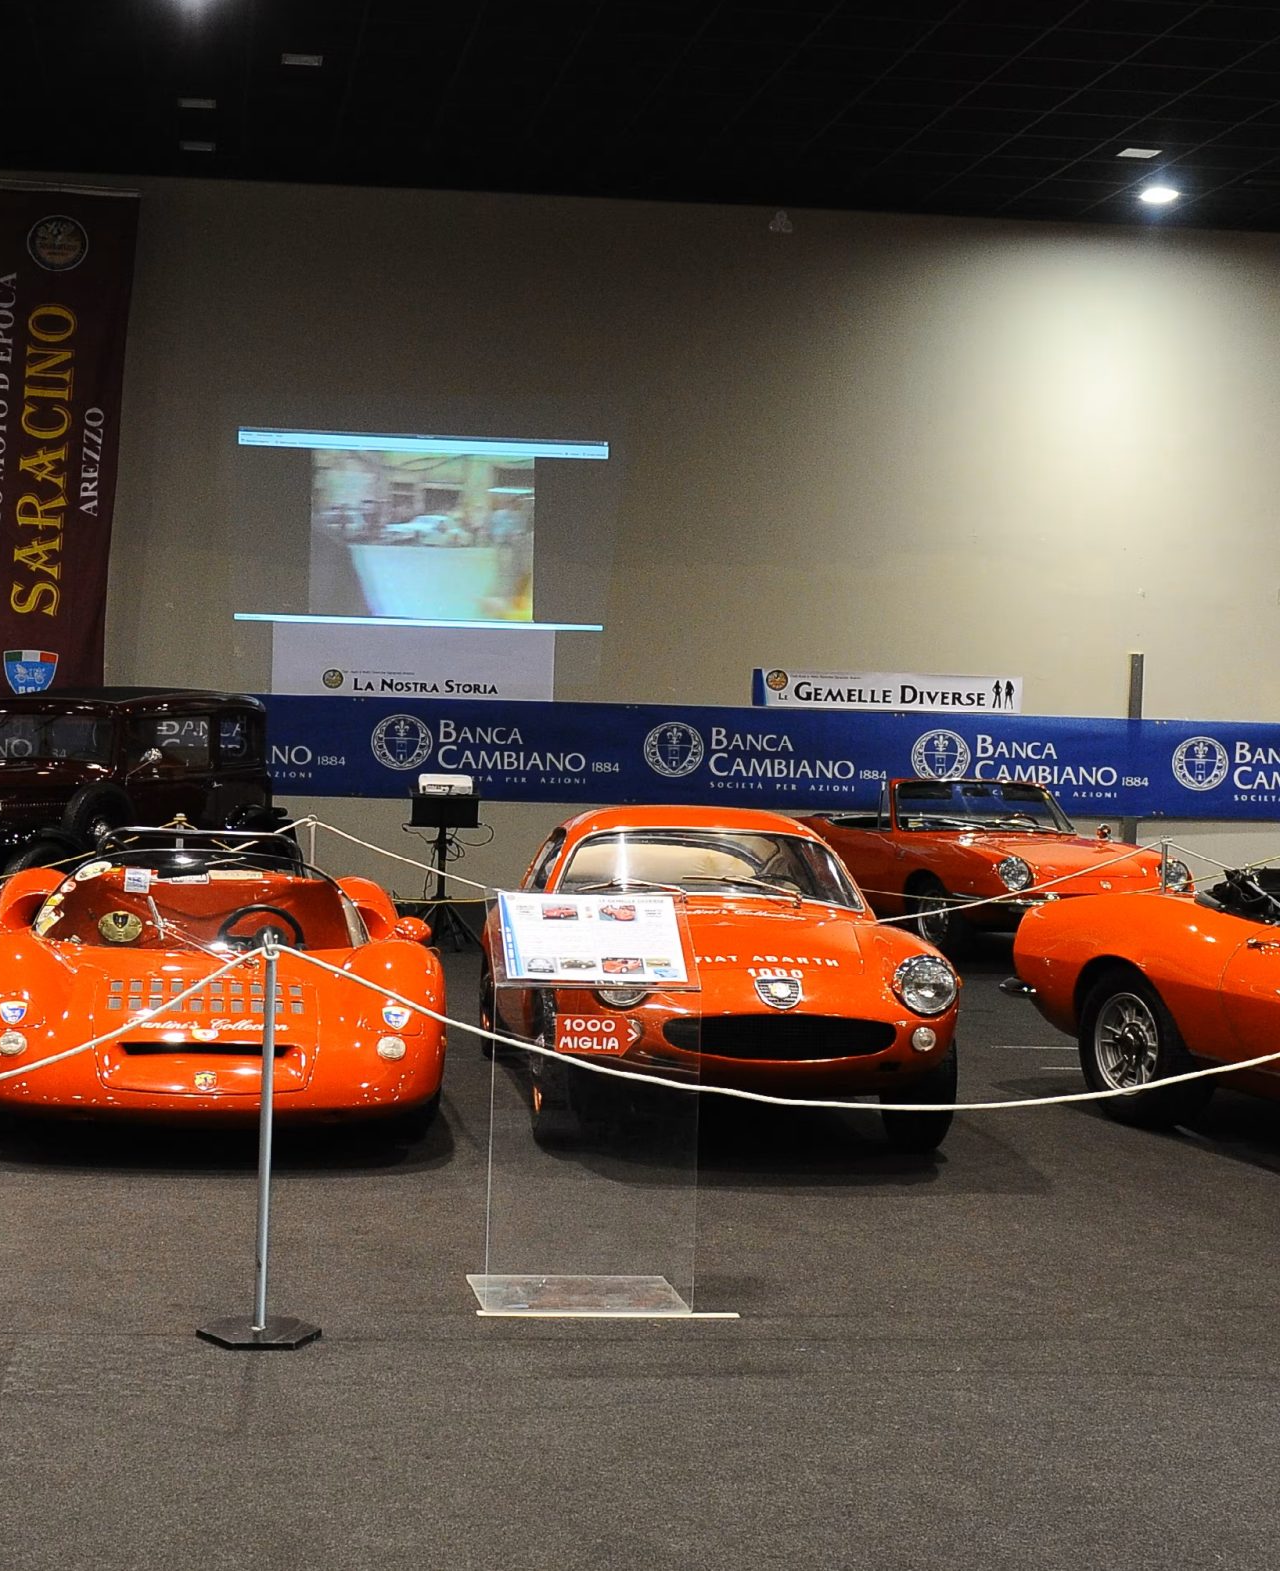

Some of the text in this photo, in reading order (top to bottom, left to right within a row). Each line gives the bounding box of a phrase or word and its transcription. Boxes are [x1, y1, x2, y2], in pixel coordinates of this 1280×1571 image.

[10, 303, 78, 617] SARACINO
[79, 407, 105, 517] AREZZO
[353, 677, 499, 695] LA NOSTRA STORIA
[794, 681, 892, 704] GEMELLE
[900, 685, 987, 707] DIVERSE
[439, 720, 524, 745] BANCA
[711, 727, 794, 752] BANCA
[976, 734, 1058, 760] BANCA
[1234, 741, 1280, 765] BAN
[317, 755, 346, 766] 1884
[437, 745, 621, 774] CAMBIANO 1884
[708, 754, 888, 781] CAMBIANO 1884
[540, 777, 587, 785] AZIONI
[975, 760, 1149, 788] CAMBIANO 1884
[776, 783, 797, 792] PER
[810, 784, 855, 793] AZIONI
[1073, 790, 1118, 799] AZIONI
[1233, 794, 1280, 802] SOCIET
[695, 954, 840, 968] FIAT ABARTH
[747, 967, 804, 979] 1000
[563, 1018, 616, 1033] 1000
[559, 1036, 620, 1050] MIGLIA
